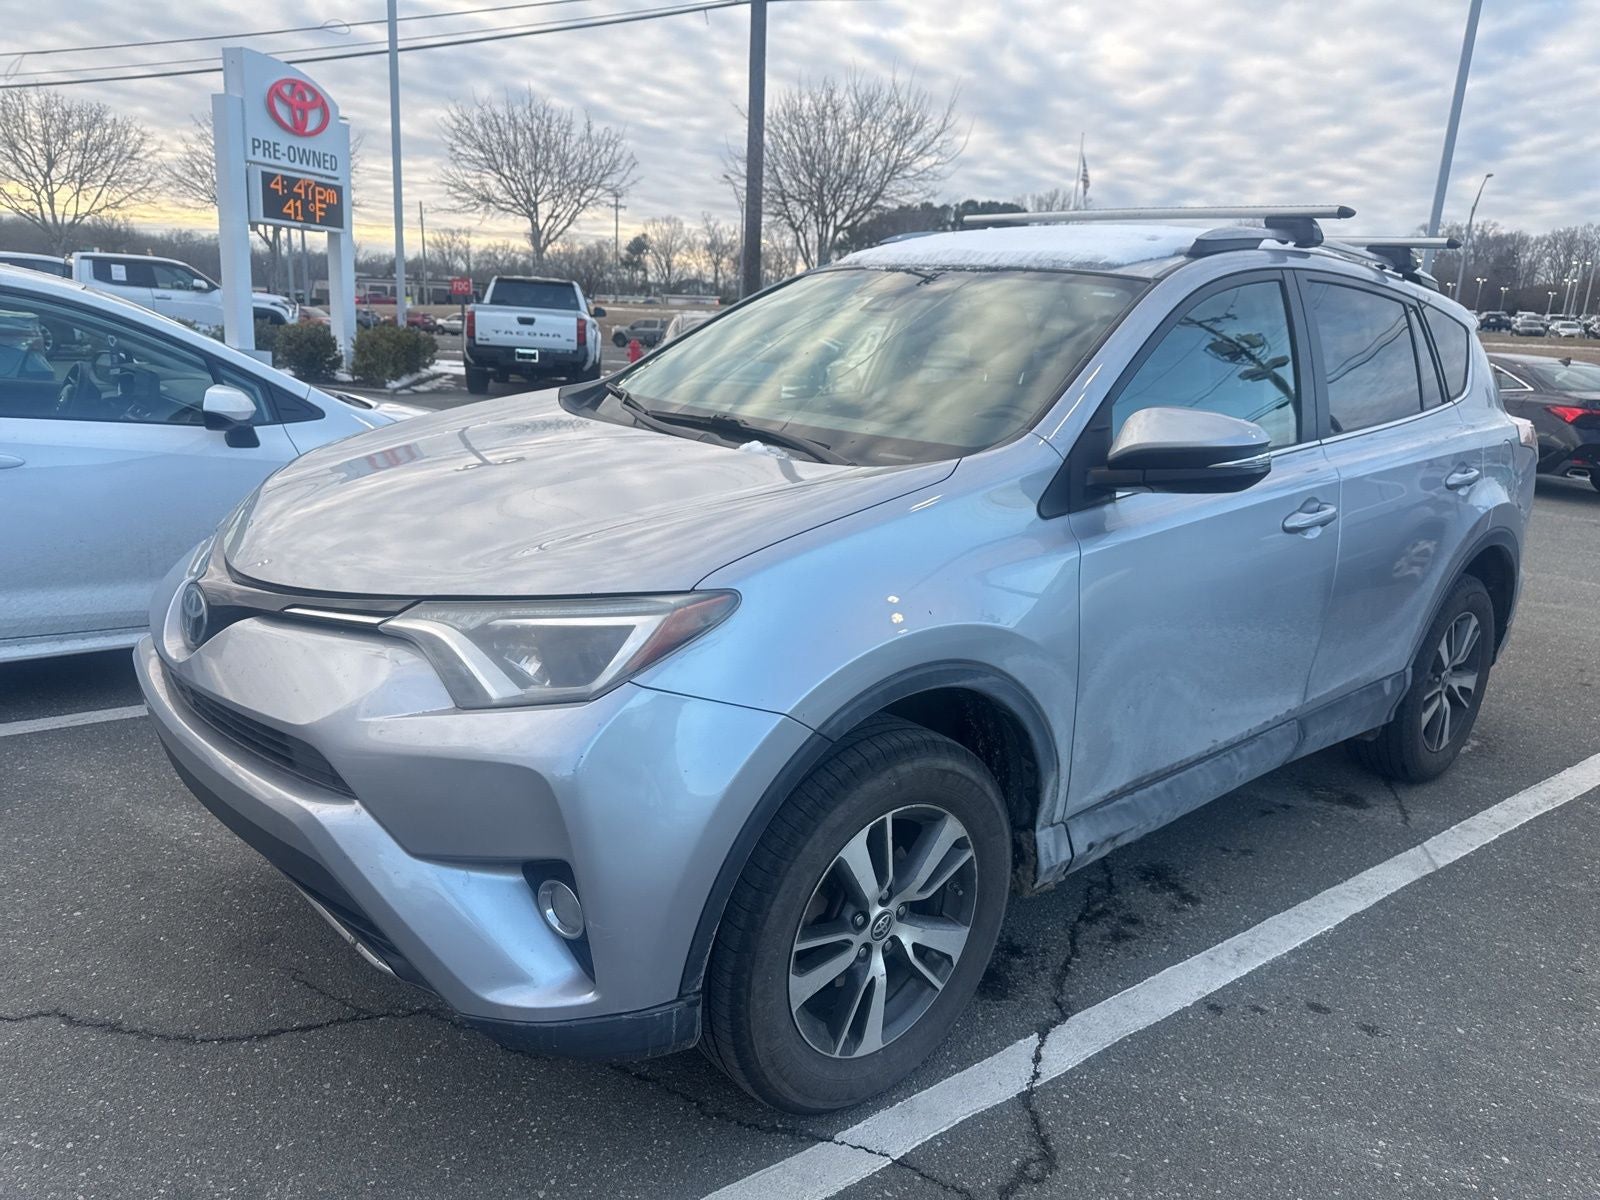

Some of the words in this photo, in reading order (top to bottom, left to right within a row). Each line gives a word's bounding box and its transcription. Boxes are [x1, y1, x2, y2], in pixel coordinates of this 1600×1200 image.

[252, 138, 337, 171] PRE-OWNED
[283, 198, 304, 222] 41
[491, 329, 561, 338] TACOMA
